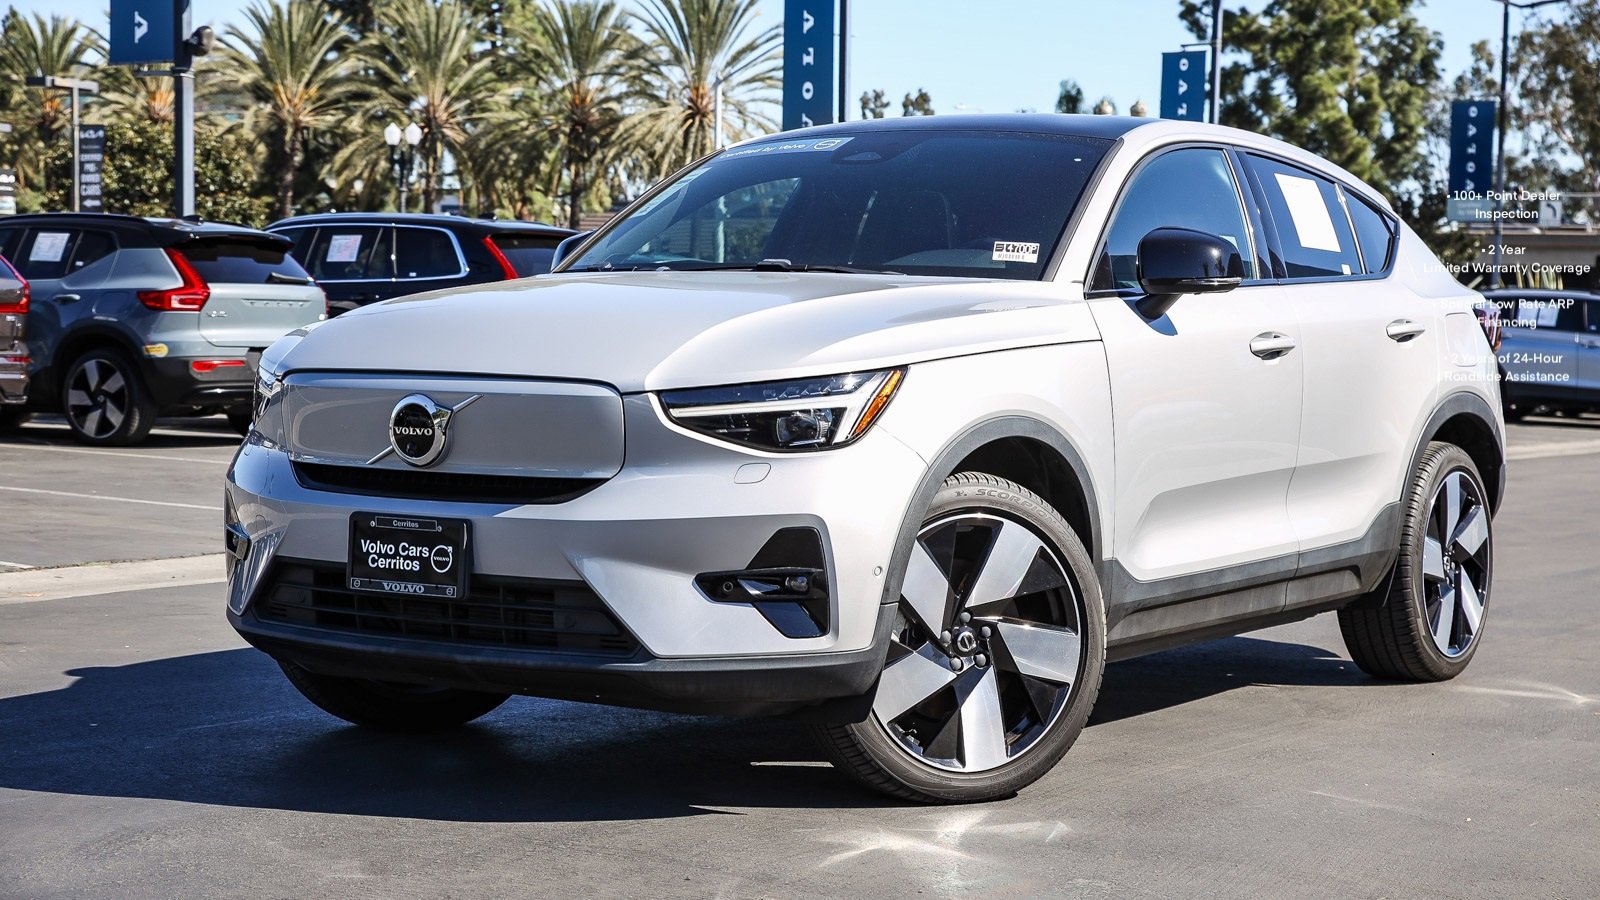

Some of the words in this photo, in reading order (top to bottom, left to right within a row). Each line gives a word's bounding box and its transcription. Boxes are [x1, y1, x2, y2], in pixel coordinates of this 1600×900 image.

[394, 426, 433, 436] VOLVO
[975, 488, 1058, 526] SCORPION
[392, 519, 419, 528] Cerritos
[361, 539, 395, 555] Volvo
[398, 542, 430, 558] Cars
[368, 555, 420, 571] Cerritos
[383, 582, 425, 594] VOLVO
